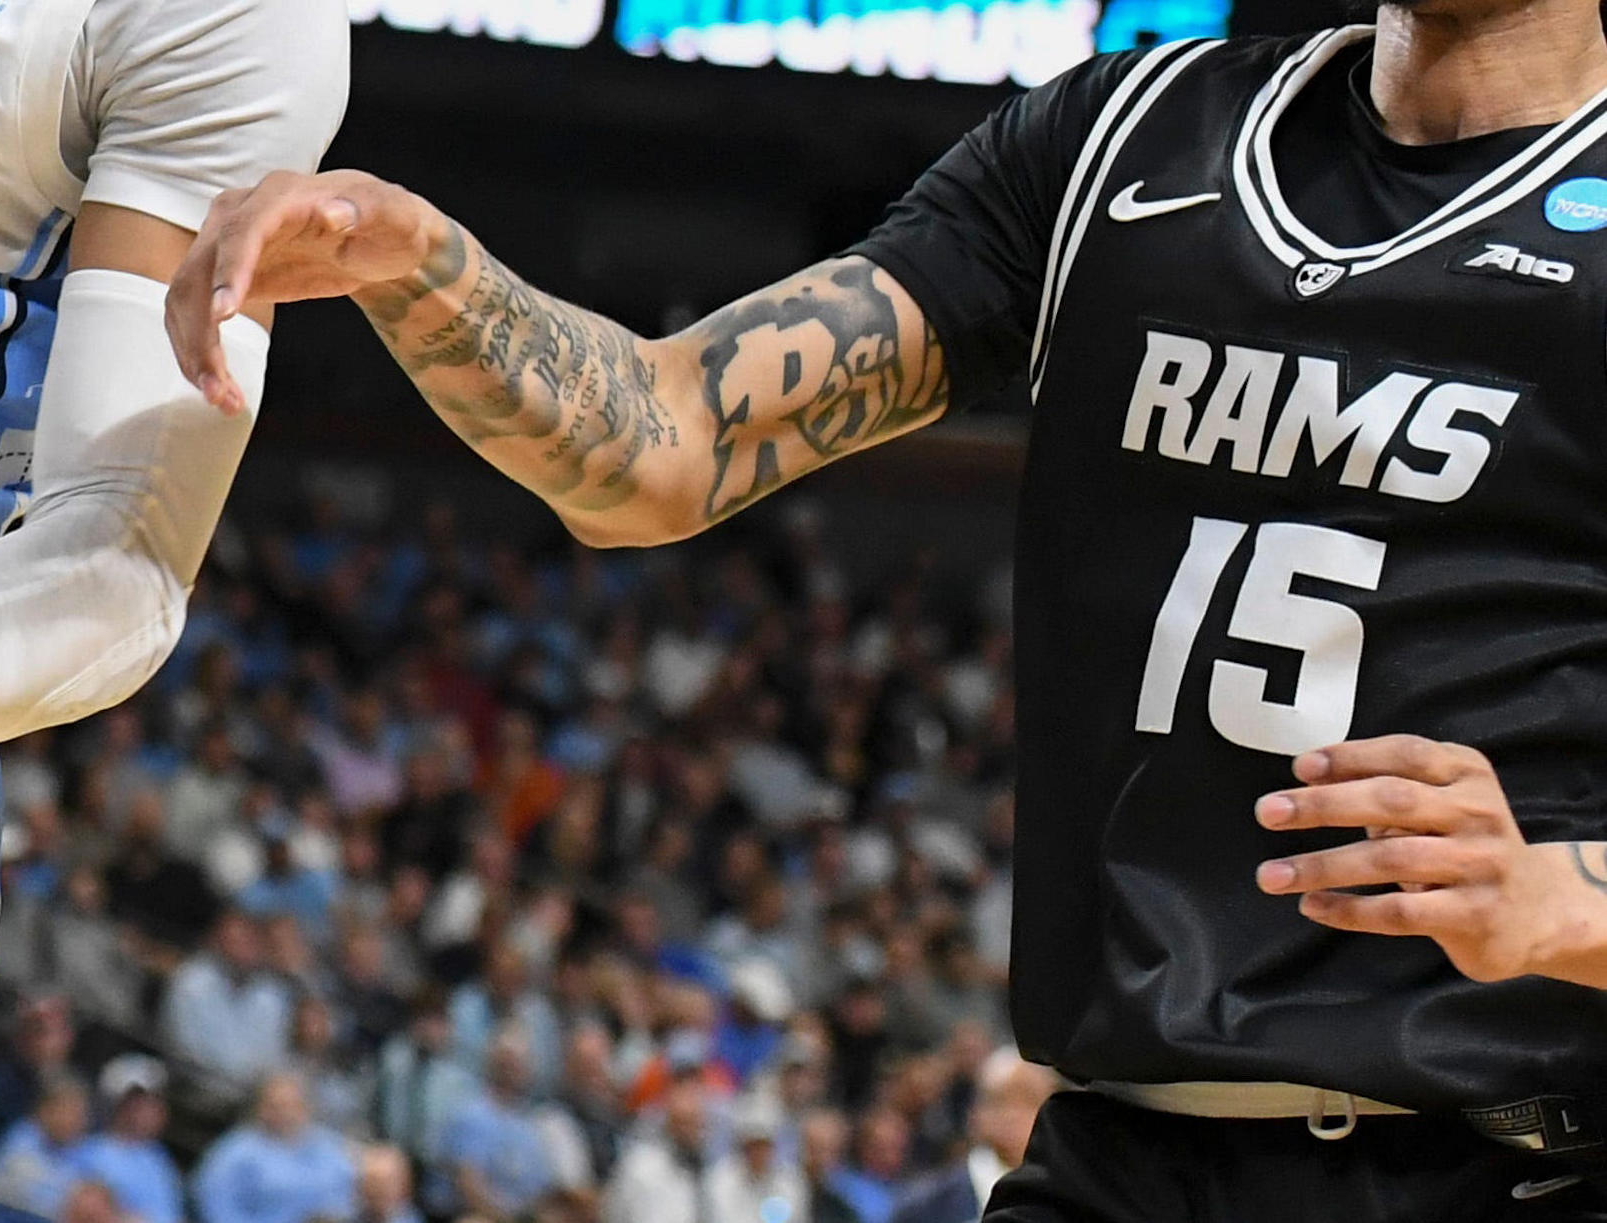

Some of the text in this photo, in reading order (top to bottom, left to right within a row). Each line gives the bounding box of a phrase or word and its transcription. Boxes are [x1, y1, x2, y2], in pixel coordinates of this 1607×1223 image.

[1463, 242, 1575, 283] A10
[1122, 330, 1521, 503] RAMS
[1135, 515, 1386, 756] 15
[1560, 1108, 1580, 1134] L
